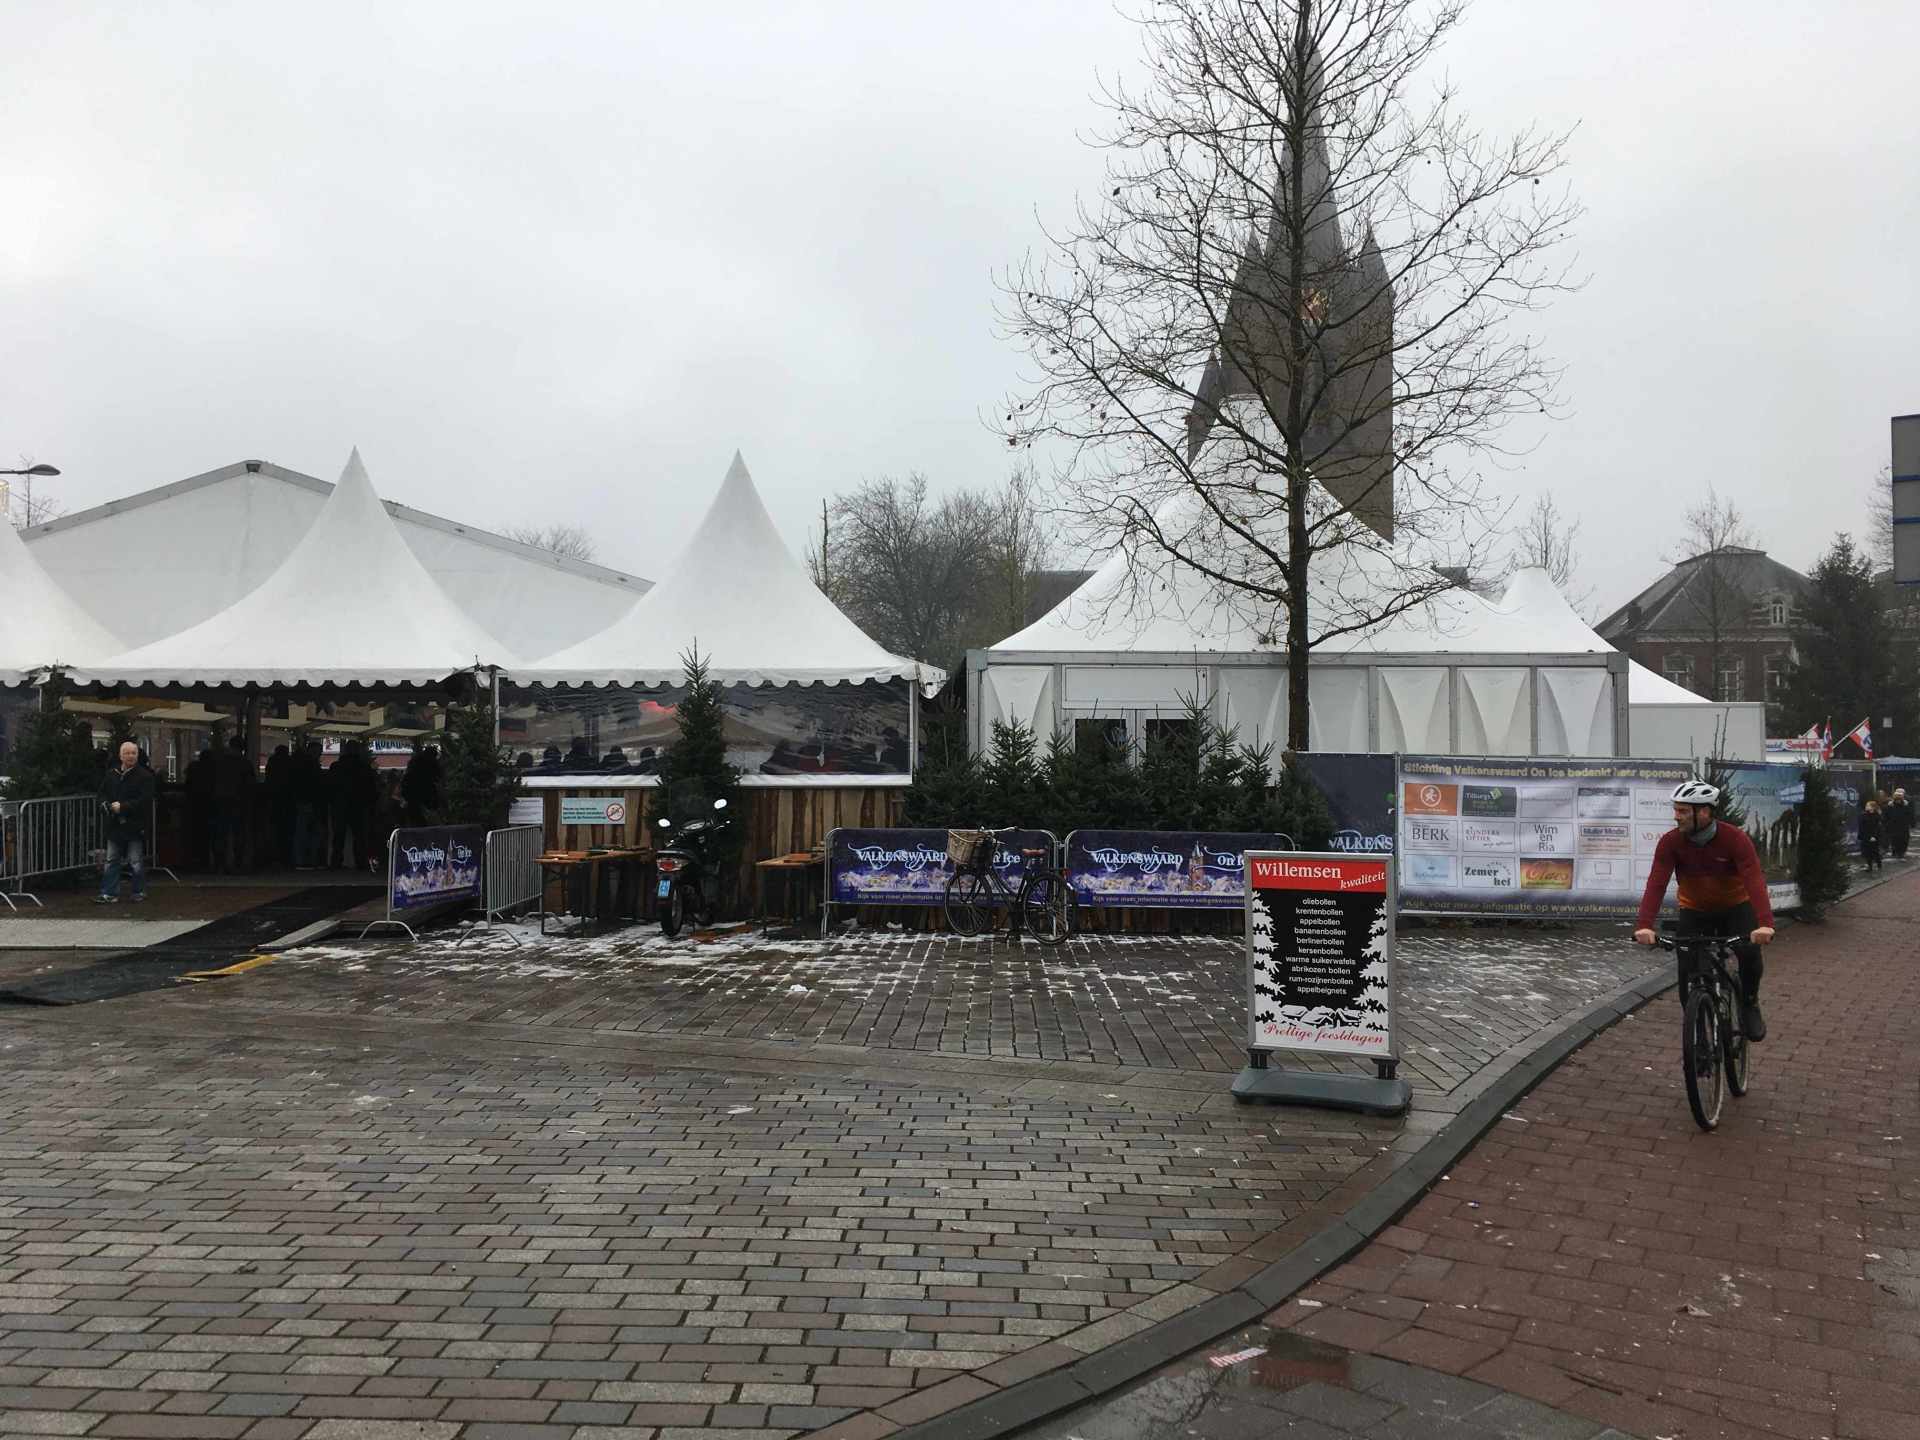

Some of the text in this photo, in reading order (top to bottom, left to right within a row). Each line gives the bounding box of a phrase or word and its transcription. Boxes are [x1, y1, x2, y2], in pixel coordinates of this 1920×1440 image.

[1404, 763, 1452, 776] Stichting
[1455, 765, 1528, 777] Valkenswaard
[1530, 767, 1546, 777] On
[1549, 767, 1565, 777] Ice
[1640, 768, 1689, 780] sponsors
[1412, 827, 1449, 841] BERK
[1534, 823, 1559, 834] Wim
[1539, 833, 1553, 842] en
[1538, 841, 1555, 852] Ria
[854, 846, 948, 867] VALKENSWAARD
[1002, 850, 1021, 864] Ice
[1089, 849, 1184, 869] VALKENSWAARD
[1217, 854, 1235, 866] On
[1255, 862, 1342, 879] Willemsen
[1464, 866, 1499, 877] Zemer
[1340, 871, 1386, 890] kwaliteit
[1302, 898, 1336, 906] oliebollen
[1295, 907, 1343, 916] krentenbollen
[1299, 917, 1341, 926] appelbollen
[1294, 926, 1346, 936] bananenbollen
[1296, 937, 1344, 946] berlinerbollen
[1298, 947, 1343, 955] kersenbollen
[1291, 966, 1351, 975] abrikozen bollen
[1264, 1023, 1384, 1046] Prettige feestdagen
